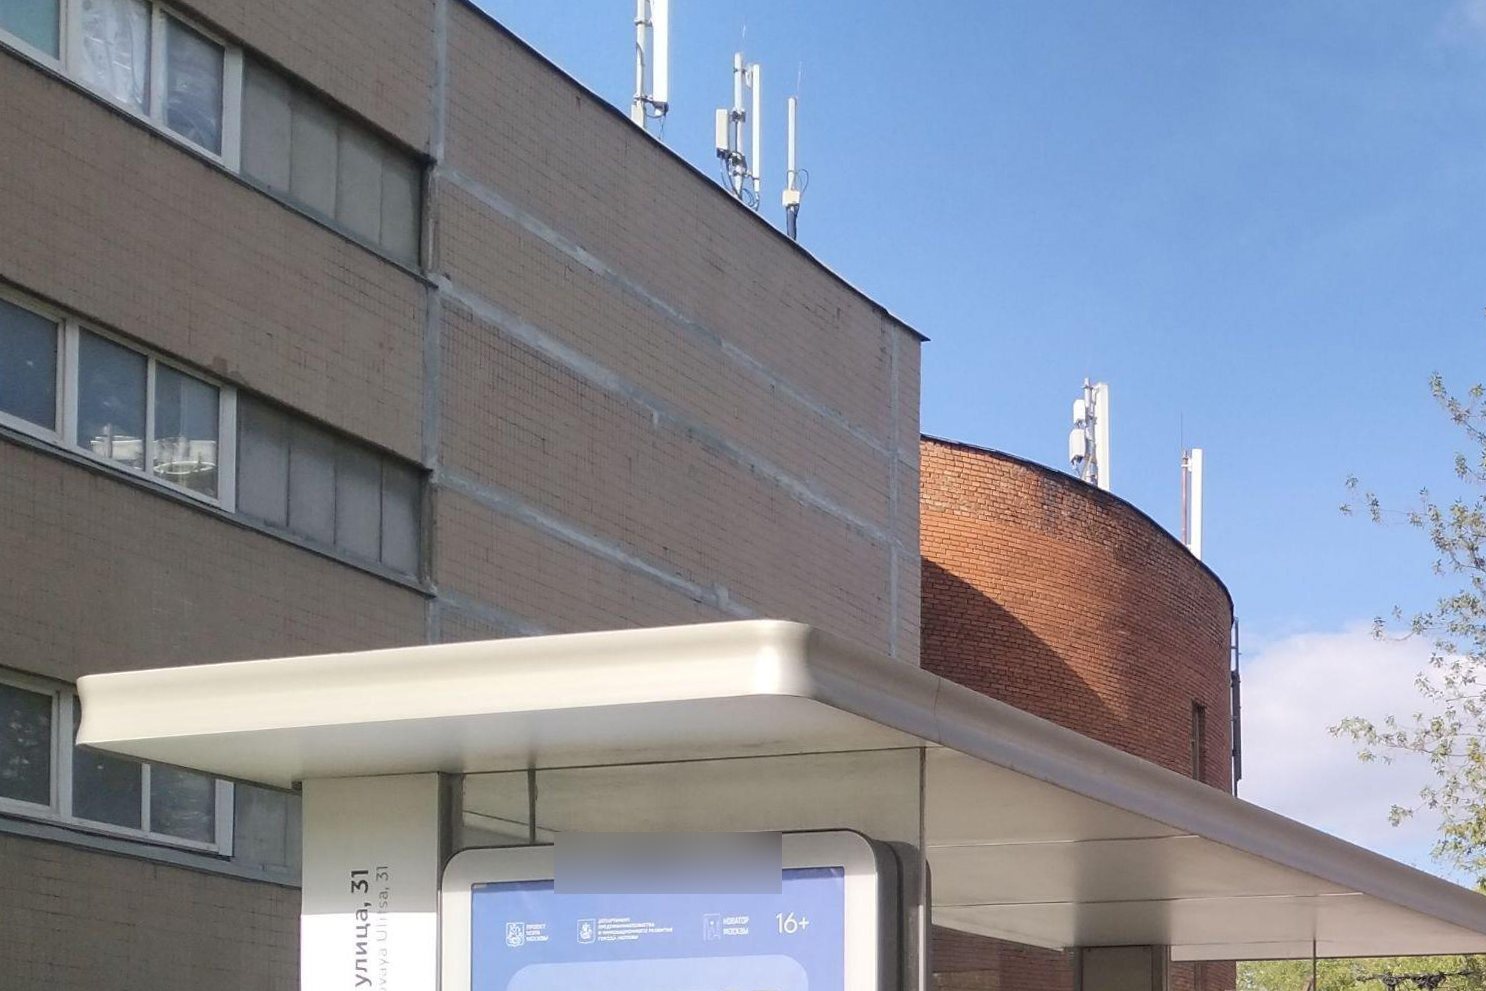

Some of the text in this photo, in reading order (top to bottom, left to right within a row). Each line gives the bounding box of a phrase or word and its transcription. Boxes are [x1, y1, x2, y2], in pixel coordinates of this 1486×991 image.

[350, 869, 369, 893] 31
[376, 866, 389, 881] 31
[375, 888, 389, 941] Ulisa,
[776, 911, 810, 934] 16+
[354, 902, 372, 987] улица,
